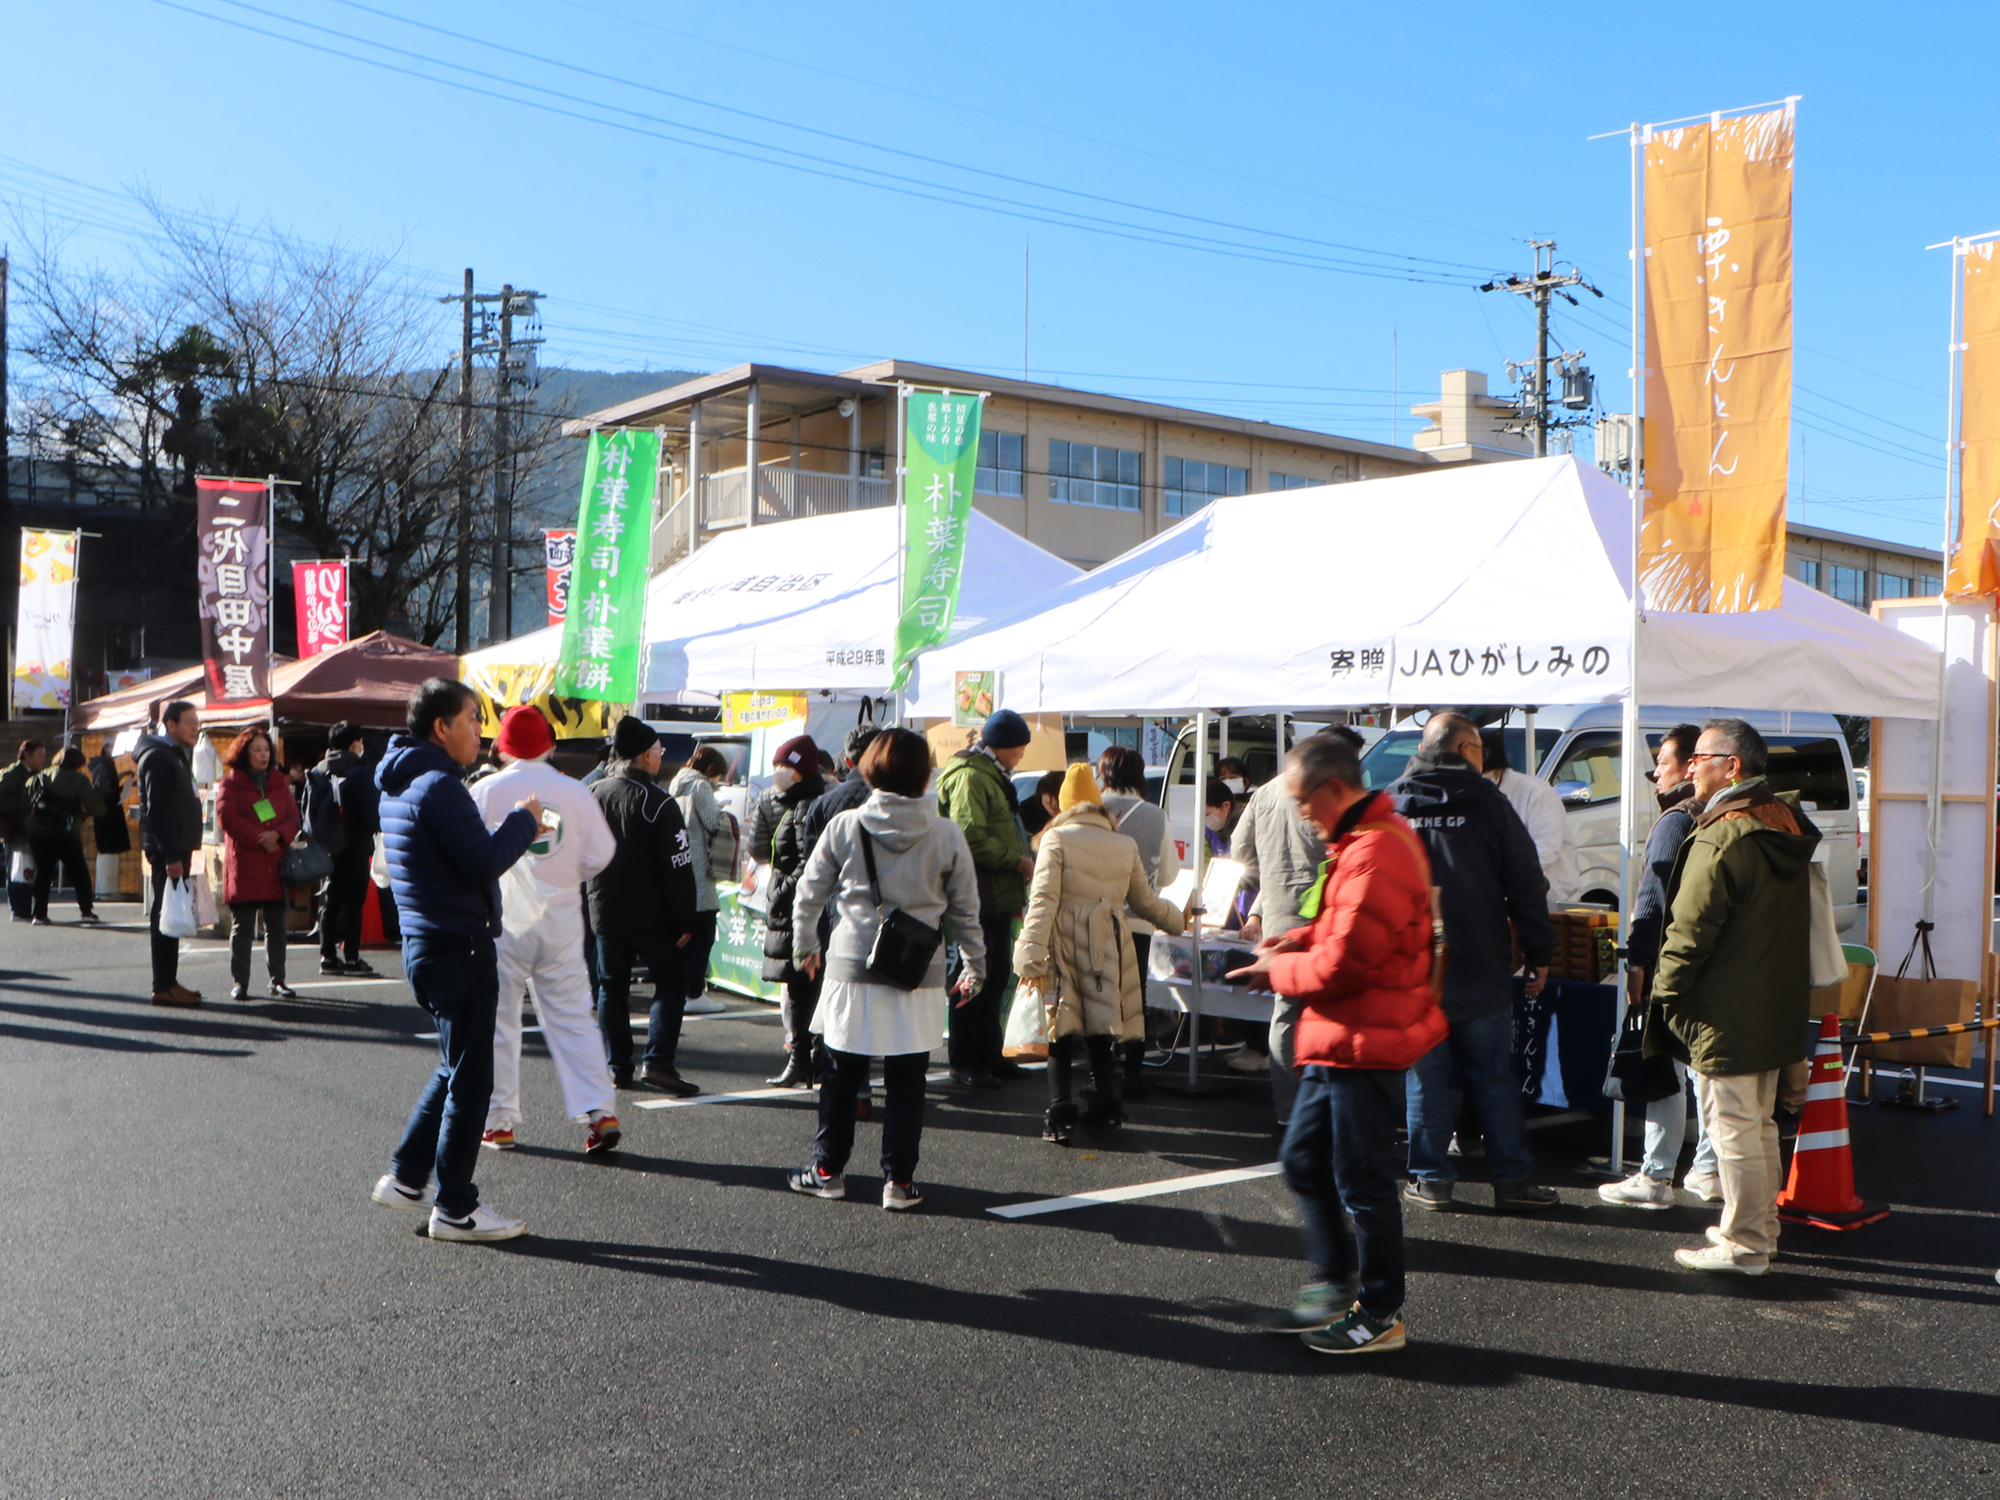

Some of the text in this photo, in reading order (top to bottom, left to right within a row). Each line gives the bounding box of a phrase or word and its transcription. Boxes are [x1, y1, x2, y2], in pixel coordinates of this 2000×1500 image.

[1695, 216, 1739, 477] 栗きんとん
[926, 401, 938, 444] 恵那の味
[941, 402, 952, 445] 郷土の香
[955, 403, 967, 446] 初夏の色
[917, 472, 963, 634] 朴葉寿司
[826, 648, 886, 667] 平成29年度
[1400, 643, 1610, 677] JAひがしみの
[1446, 816, 1466, 828] GP
